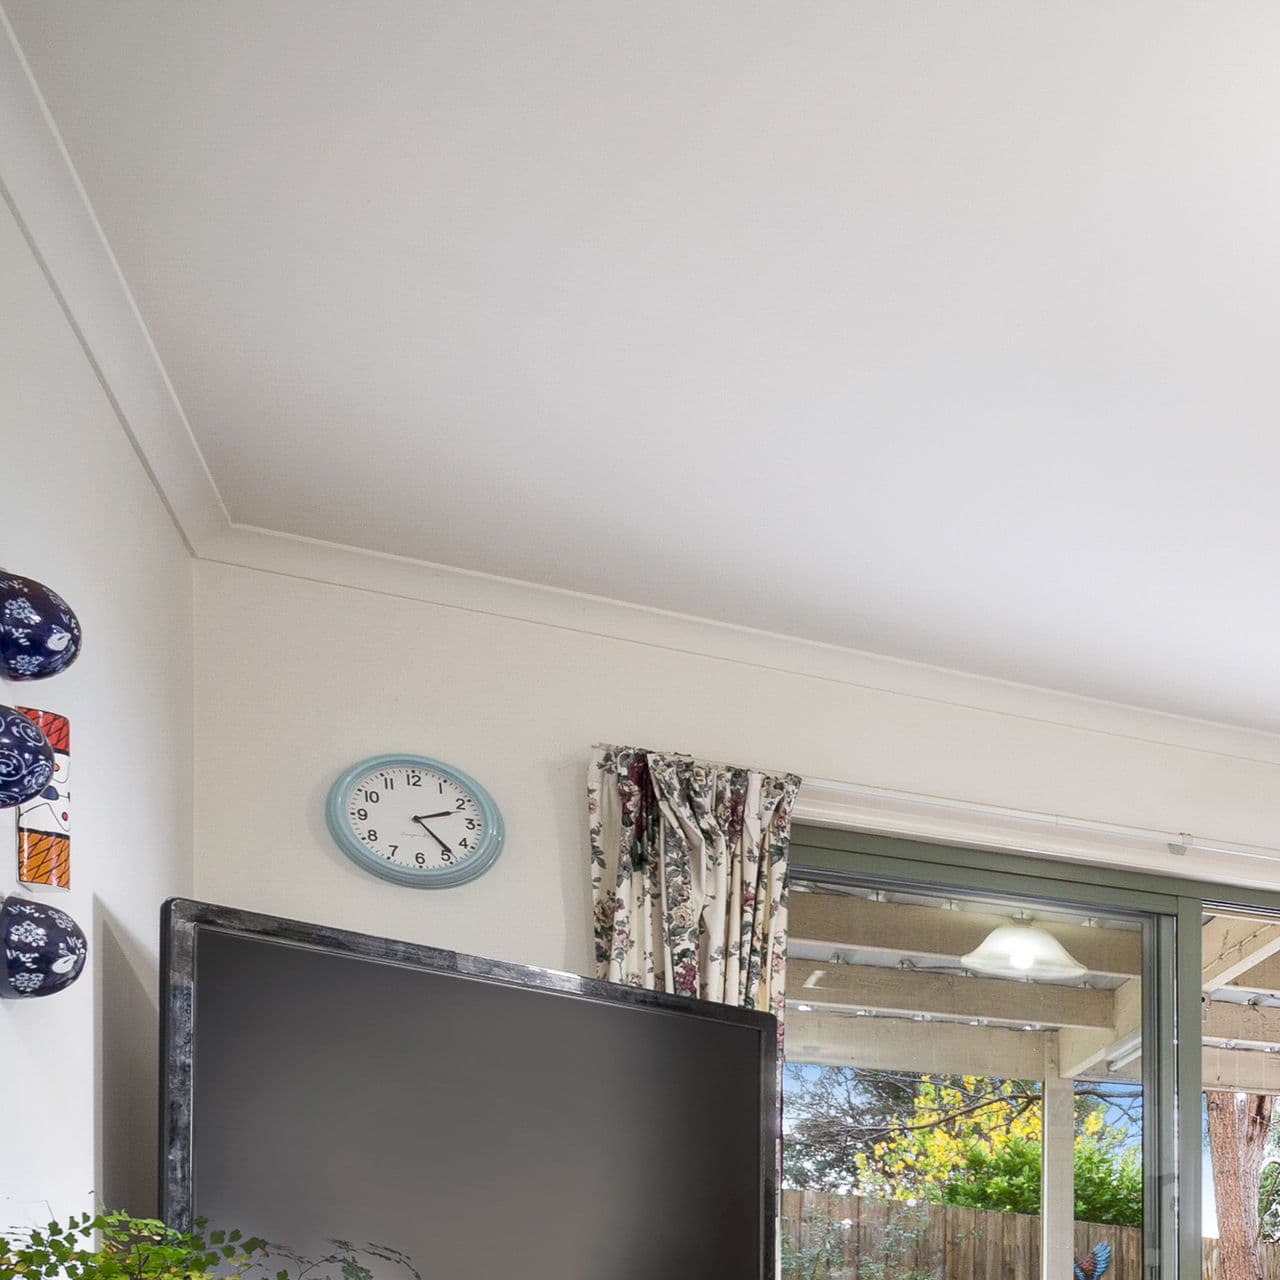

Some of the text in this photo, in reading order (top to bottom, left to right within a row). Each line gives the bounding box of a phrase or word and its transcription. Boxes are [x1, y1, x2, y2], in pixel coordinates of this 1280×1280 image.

[384, 778, 394, 790] 11
[406, 773, 422, 787] 12
[438, 782, 443, 794] 1
[364, 790, 380, 803] 10
[455, 798, 466, 810] 2
[357, 808, 368, 821] 9
[465, 818, 476, 830] 3
[367, 829, 378, 842] 8
[458, 837, 469, 849] 4
[388, 845, 399, 857] 7
[440, 849, 452, 862] 5
[415, 852, 426, 865] 6
